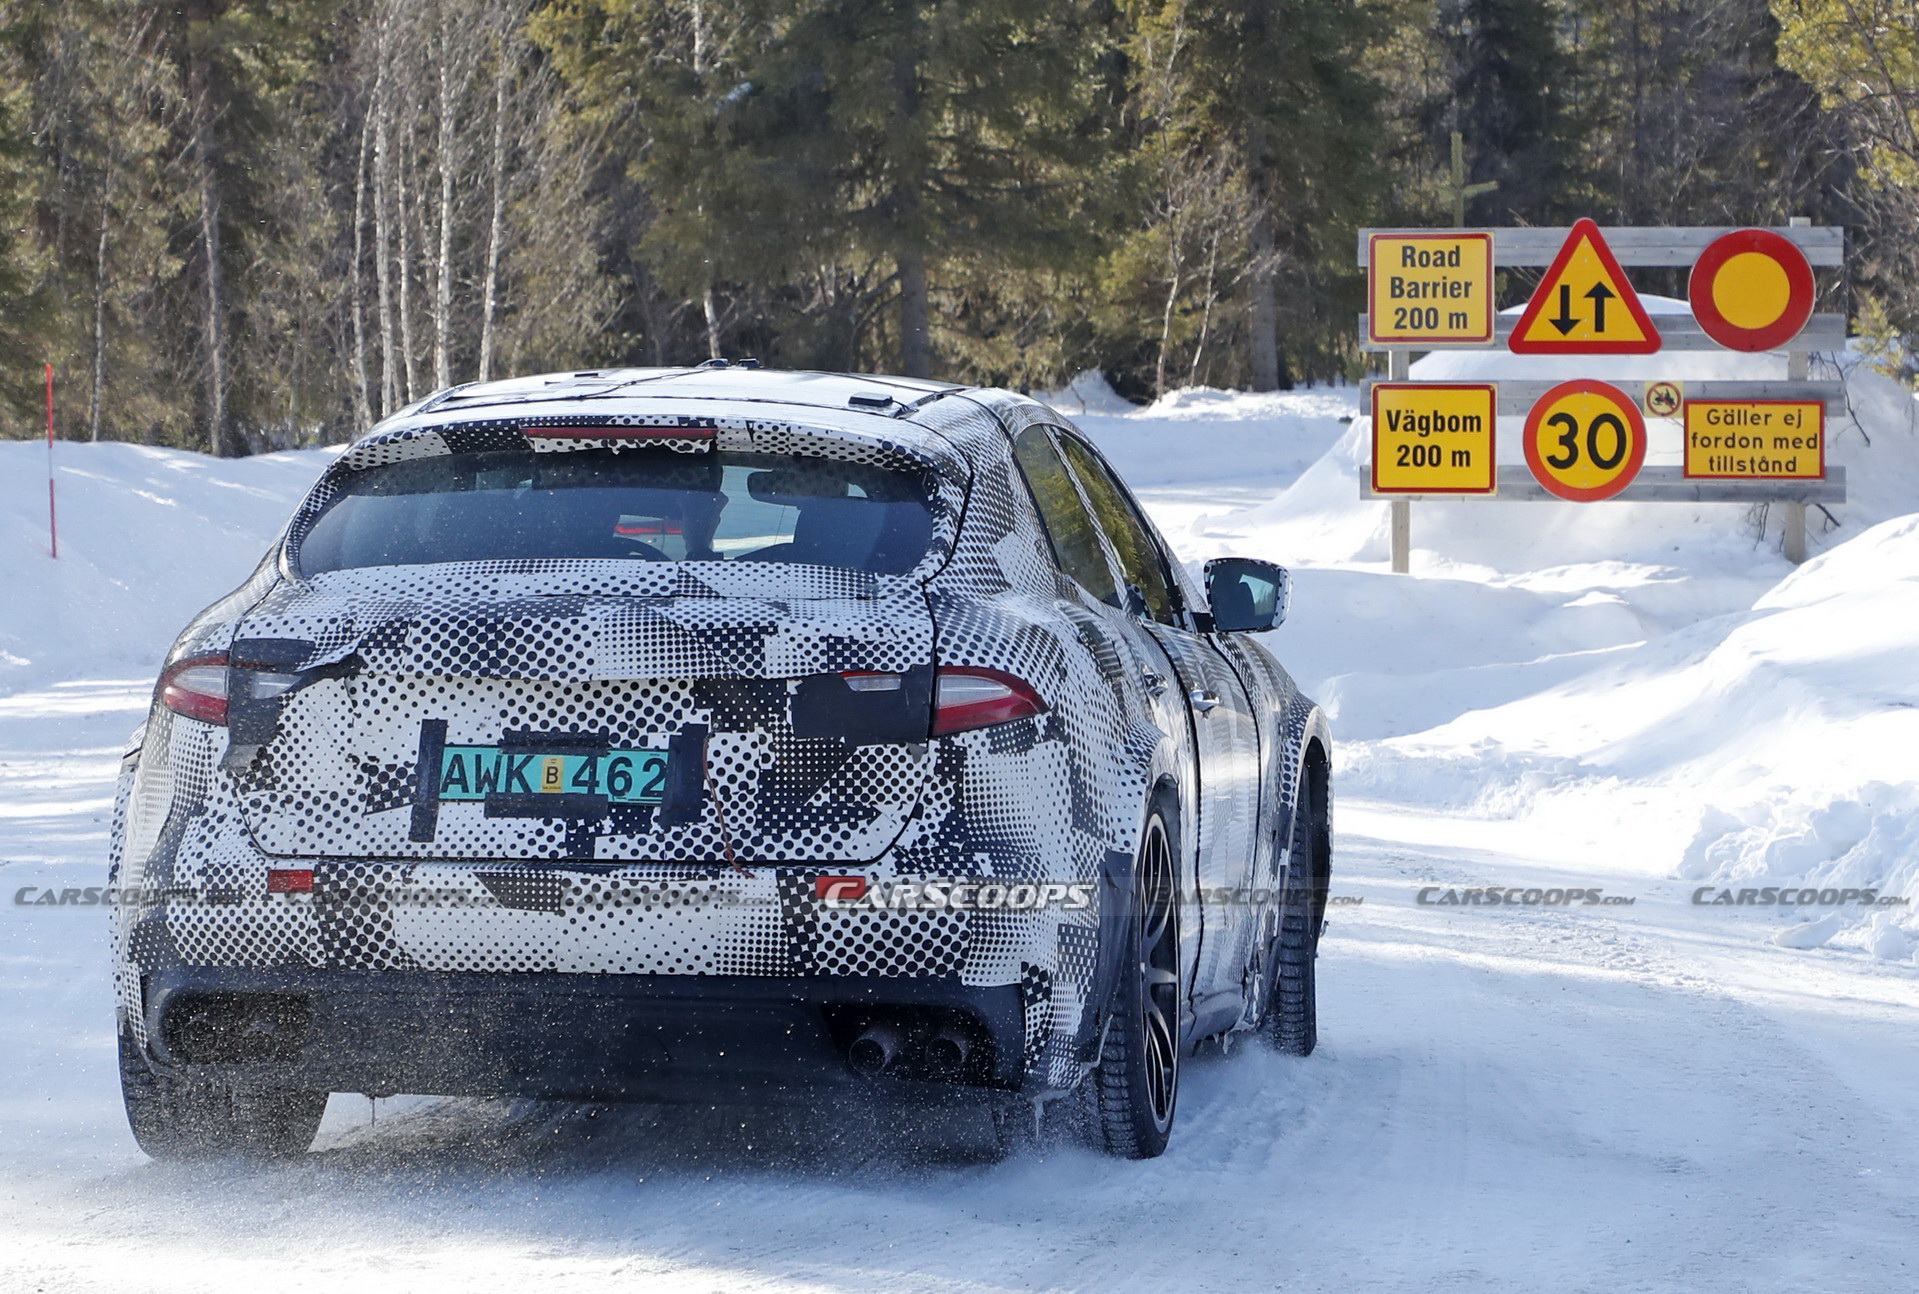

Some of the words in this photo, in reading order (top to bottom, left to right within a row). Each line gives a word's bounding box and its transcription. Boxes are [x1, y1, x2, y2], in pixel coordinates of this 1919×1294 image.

[1401, 245, 1461, 268] Road
[1390, 276, 1473, 299] Barrier
[1393, 307, 1440, 330] 200
[1448, 311, 1468, 329] m
[1386, 409, 1482, 438] Vägbom
[1706, 408, 1773, 426] Gäller
[1783, 408, 1803, 429] ej
[1546, 412, 1627, 470] 30
[1691, 431, 1764, 449] fordon
[1773, 432, 1819, 450] med
[1396, 444, 1443, 467] 200
[1451, 449, 1471, 467] m
[1708, 455, 1798, 474] tillstånd
[440, 753, 536, 794] AWK
[571, 755, 667, 797] 462
[546, 766, 558, 784] B
